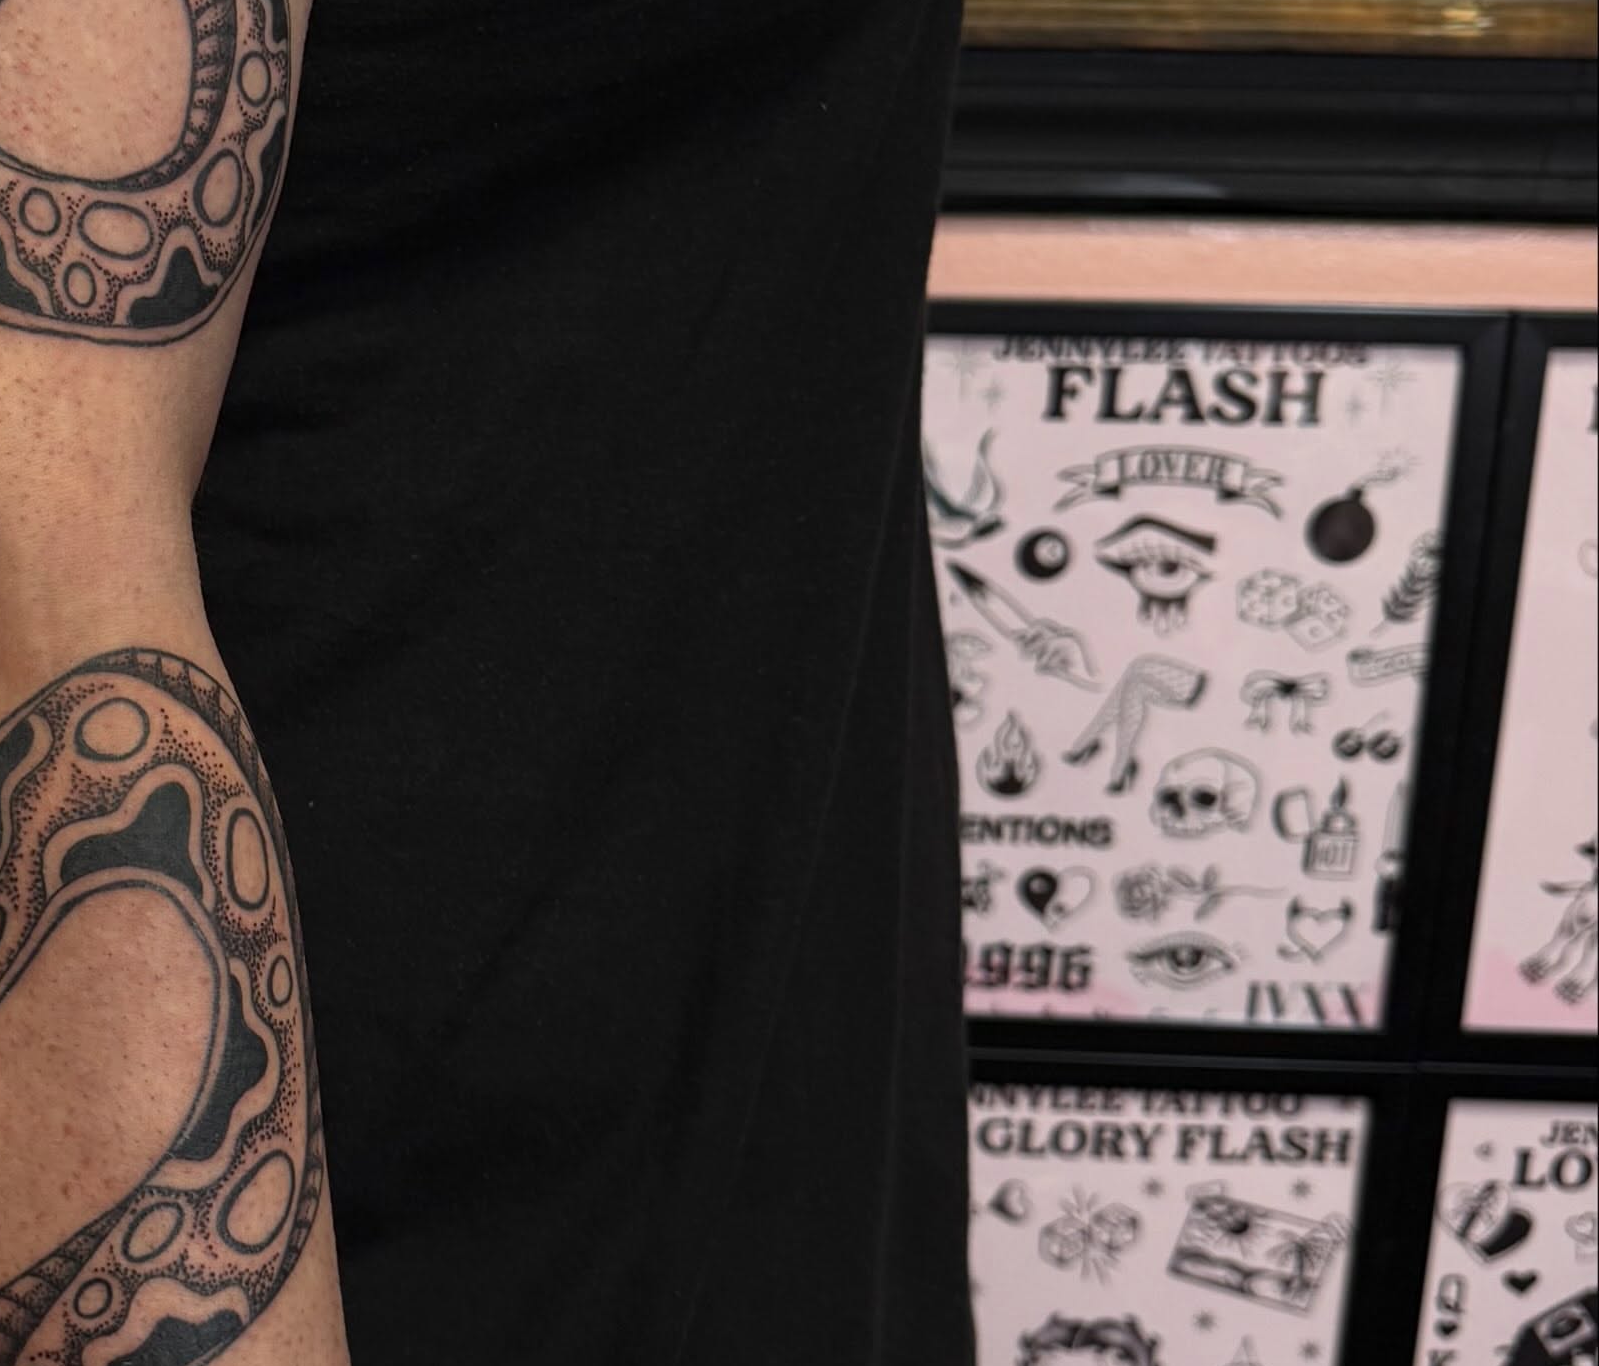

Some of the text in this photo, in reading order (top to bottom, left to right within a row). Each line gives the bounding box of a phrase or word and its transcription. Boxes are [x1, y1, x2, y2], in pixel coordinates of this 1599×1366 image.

[993, 336, 1187, 363] JENNYLEE
[1042, 364, 1326, 426] FLASH
[1117, 449, 1227, 485] LOVER
[1134, 1089, 1302, 1117] TATTOO
[975, 1116, 1352, 1166] GLORY FLASH
